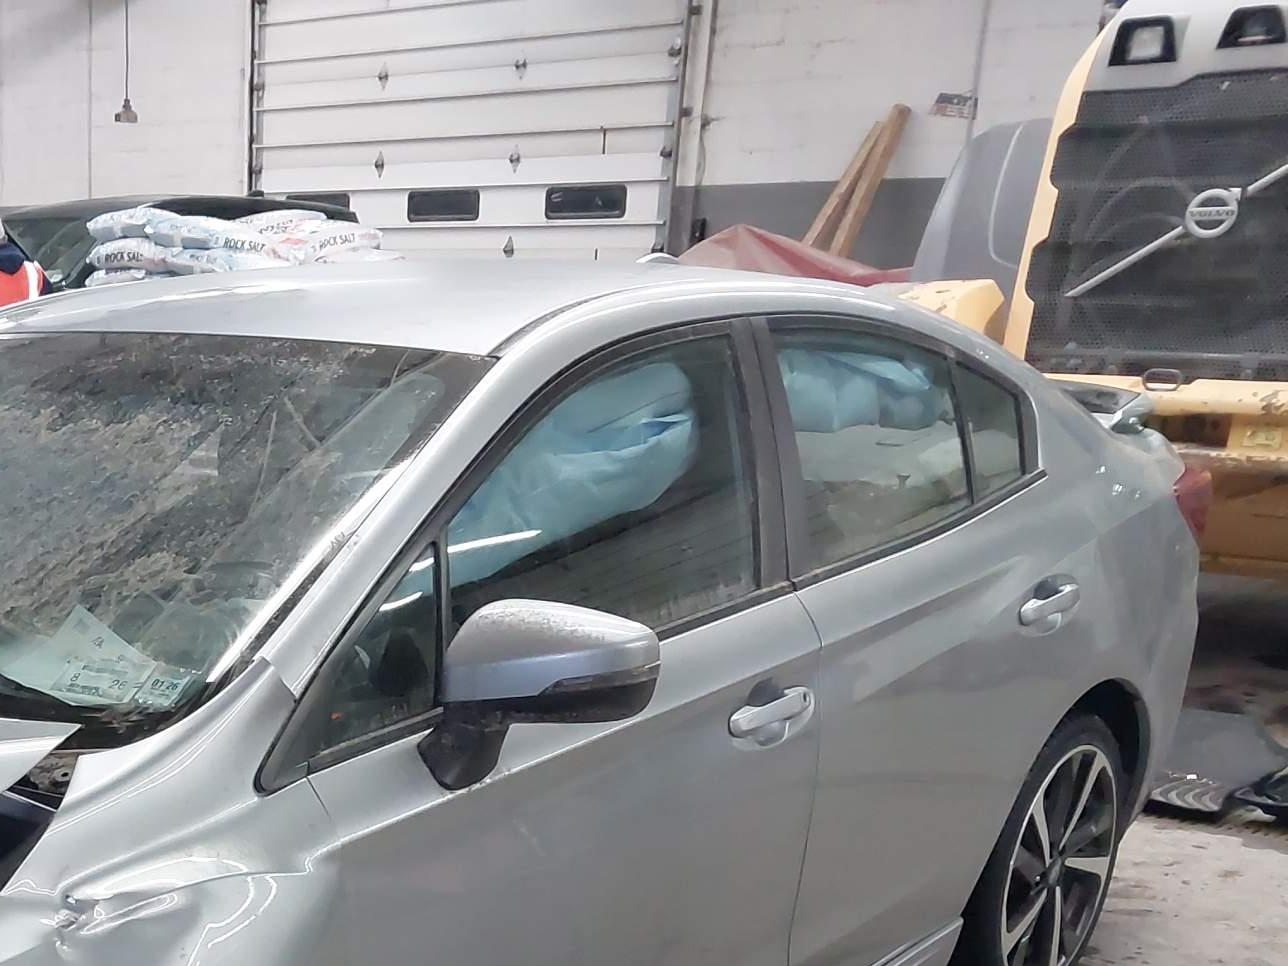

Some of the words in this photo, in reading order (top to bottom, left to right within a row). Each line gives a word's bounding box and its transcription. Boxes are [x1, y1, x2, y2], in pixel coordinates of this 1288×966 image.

[1188, 208, 1236, 218] VOLVO
[223, 236, 247, 250] ROCK
[247, 239, 267, 253] SALT
[151, 677, 165, 688] 01
[165, 681, 179, 691] 26
